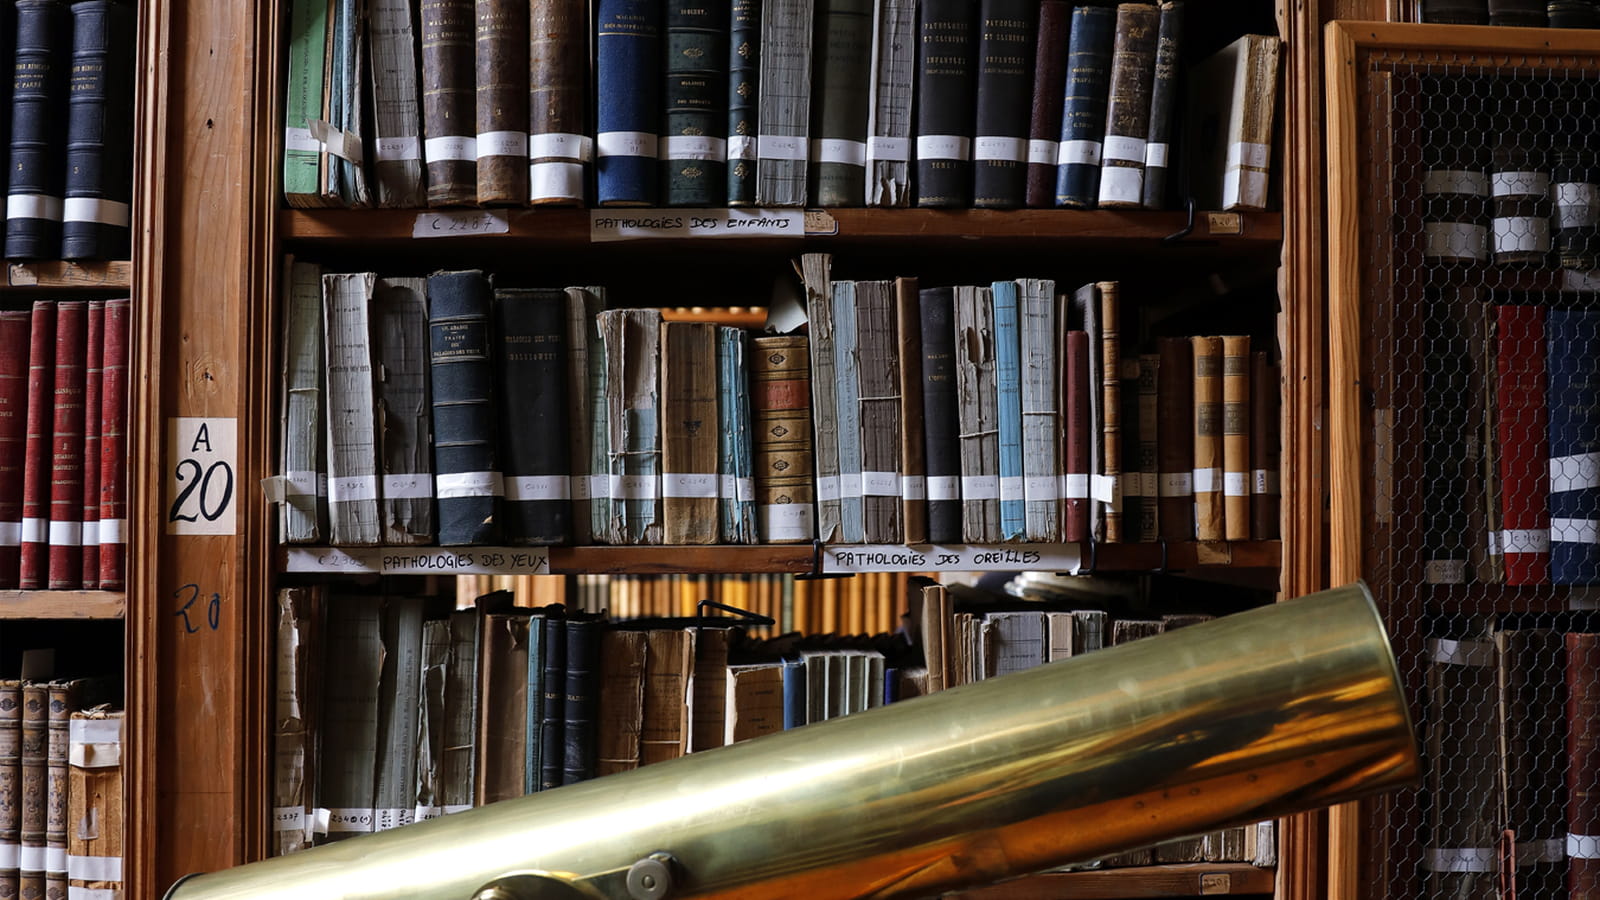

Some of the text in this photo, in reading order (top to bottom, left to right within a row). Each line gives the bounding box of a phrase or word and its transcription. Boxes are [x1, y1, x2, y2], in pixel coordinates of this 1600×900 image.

[985, 20, 1025, 29] PATHOLOGI
[595, 217, 683, 230] PATHOLOGIES
[689, 218, 718, 230] DES
[726, 217, 791, 230] ENFANTS
[191, 422, 213, 452] A
[168, 458, 234, 524] 20
[383, 553, 548, 574] PATHOLOGIES DES YEUX
[835, 547, 1041, 567] PATHOLOGIES DES OREILLES
